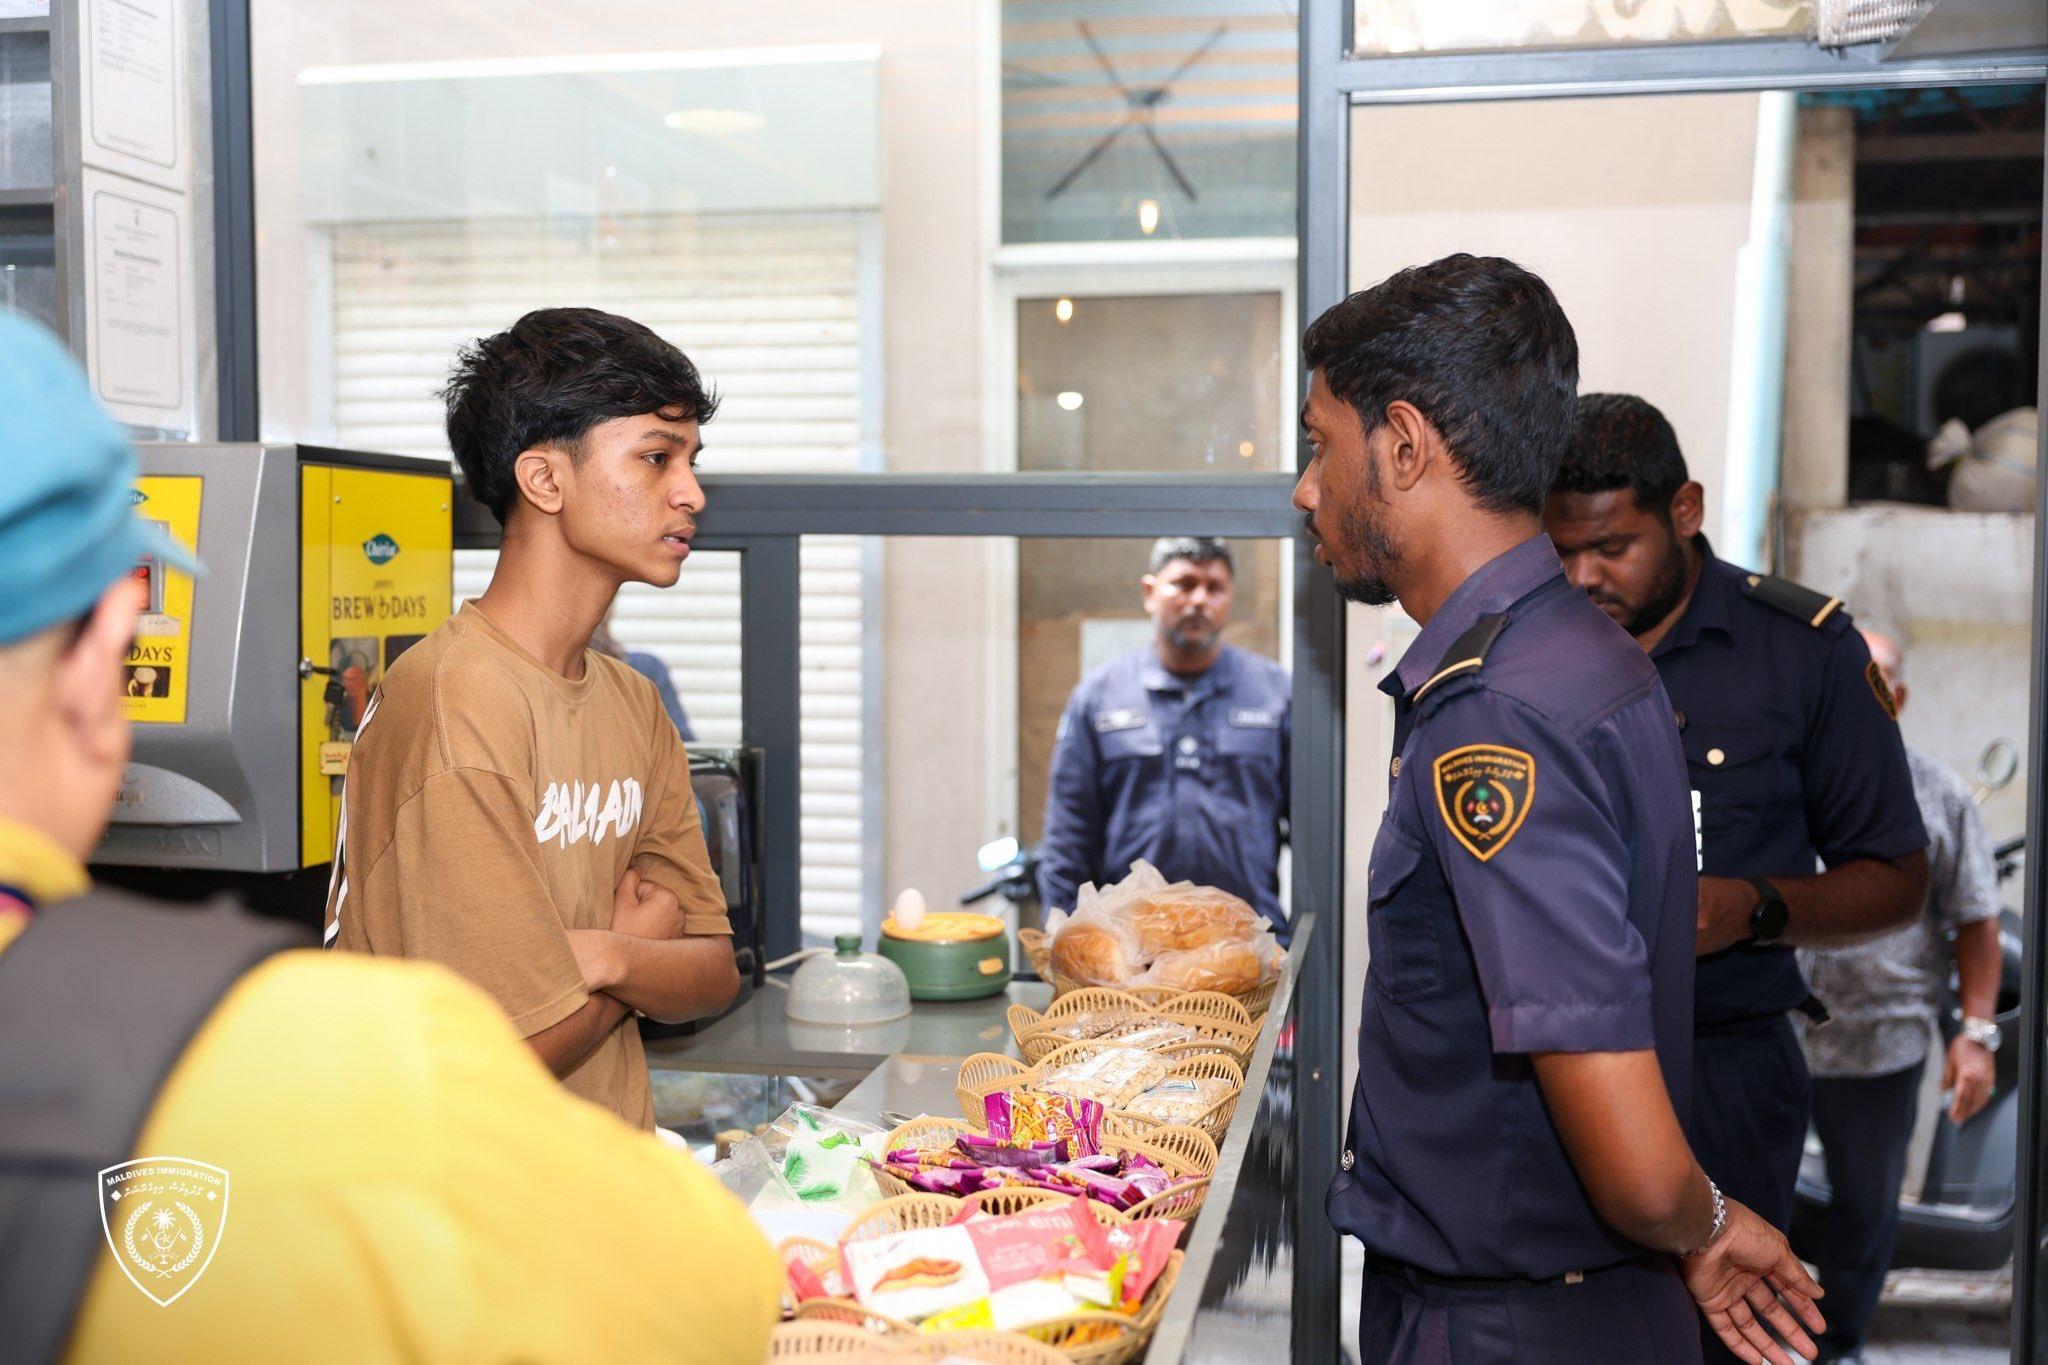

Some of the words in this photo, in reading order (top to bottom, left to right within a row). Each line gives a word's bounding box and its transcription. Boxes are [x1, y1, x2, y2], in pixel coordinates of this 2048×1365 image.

[332, 596, 374, 620] BREW
[391, 595, 427, 619] DAYS
[130, 646, 172, 662] DAYS
